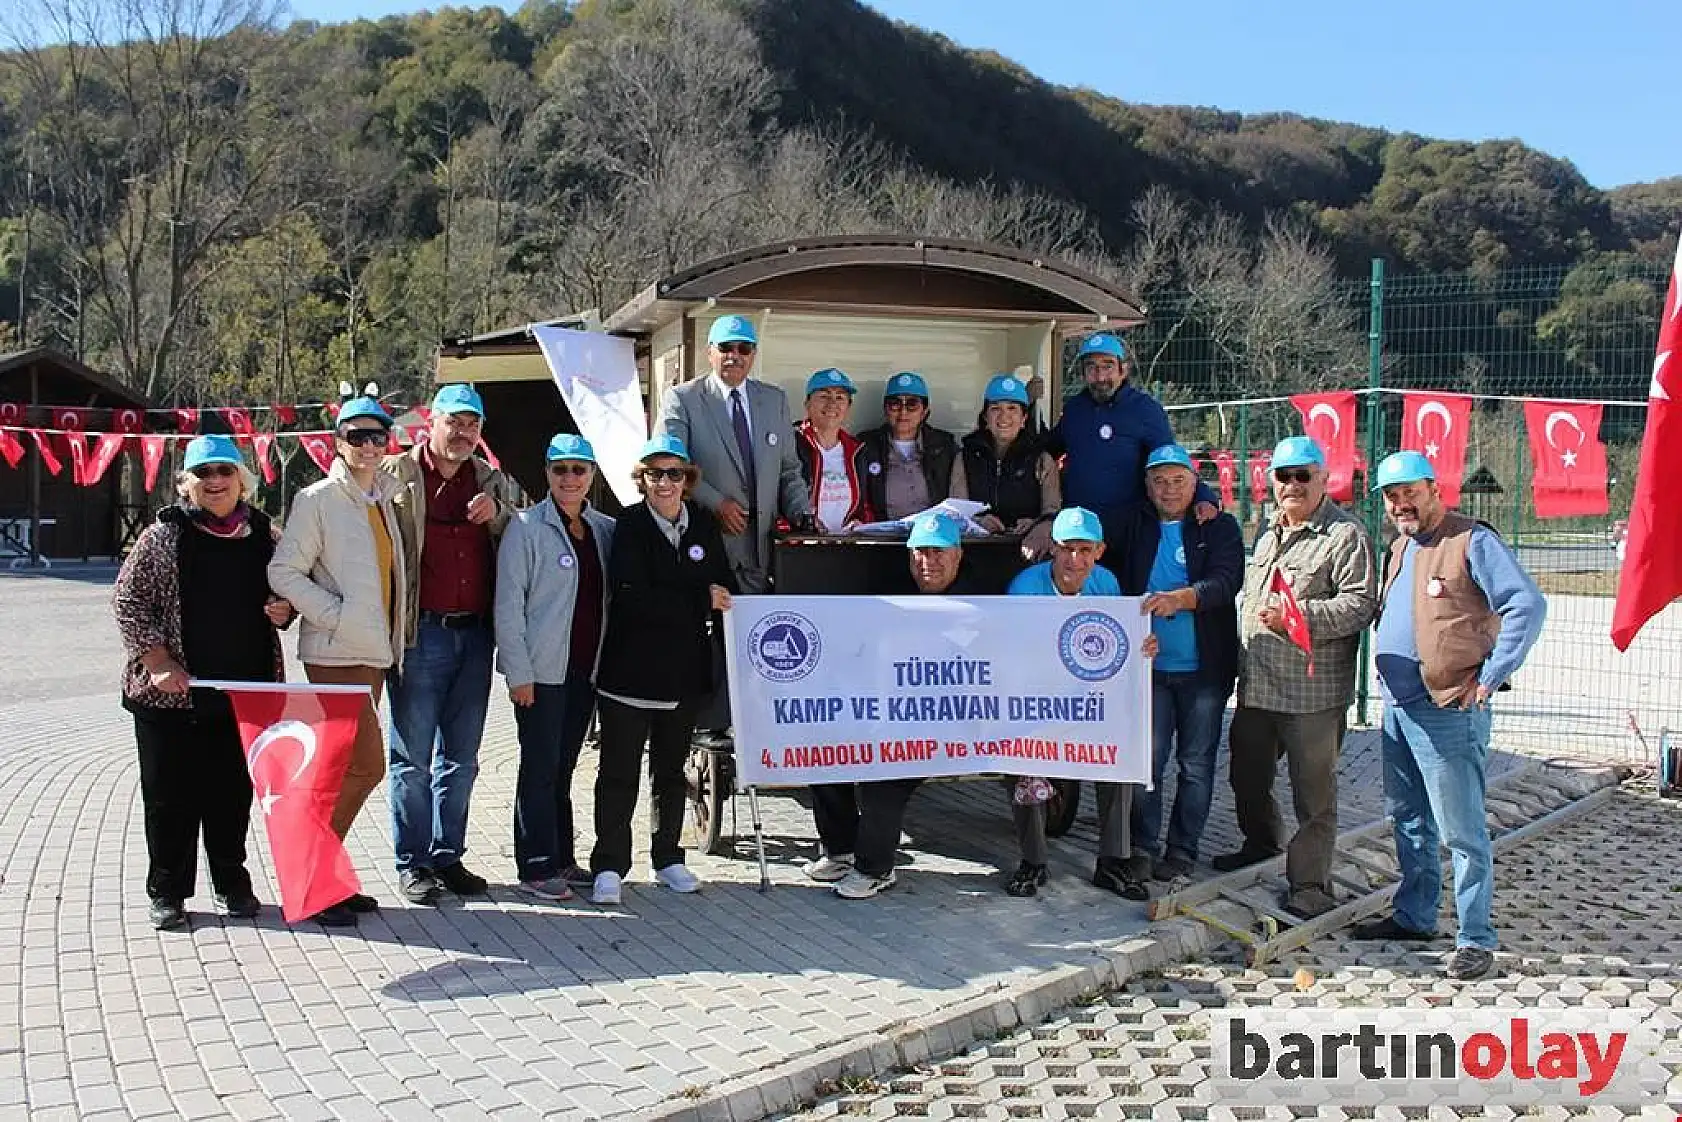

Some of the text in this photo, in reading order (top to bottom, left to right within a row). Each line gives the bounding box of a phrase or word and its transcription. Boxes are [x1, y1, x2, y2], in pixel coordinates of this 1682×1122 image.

[893, 656, 992, 687] TÜRKİYE
[773, 692, 1104, 724] KAMP VE KARAVAN DERNEĞİ
[761, 738, 1118, 769] 4. ANADOLU KAMP ve KARAVAN RALLY
